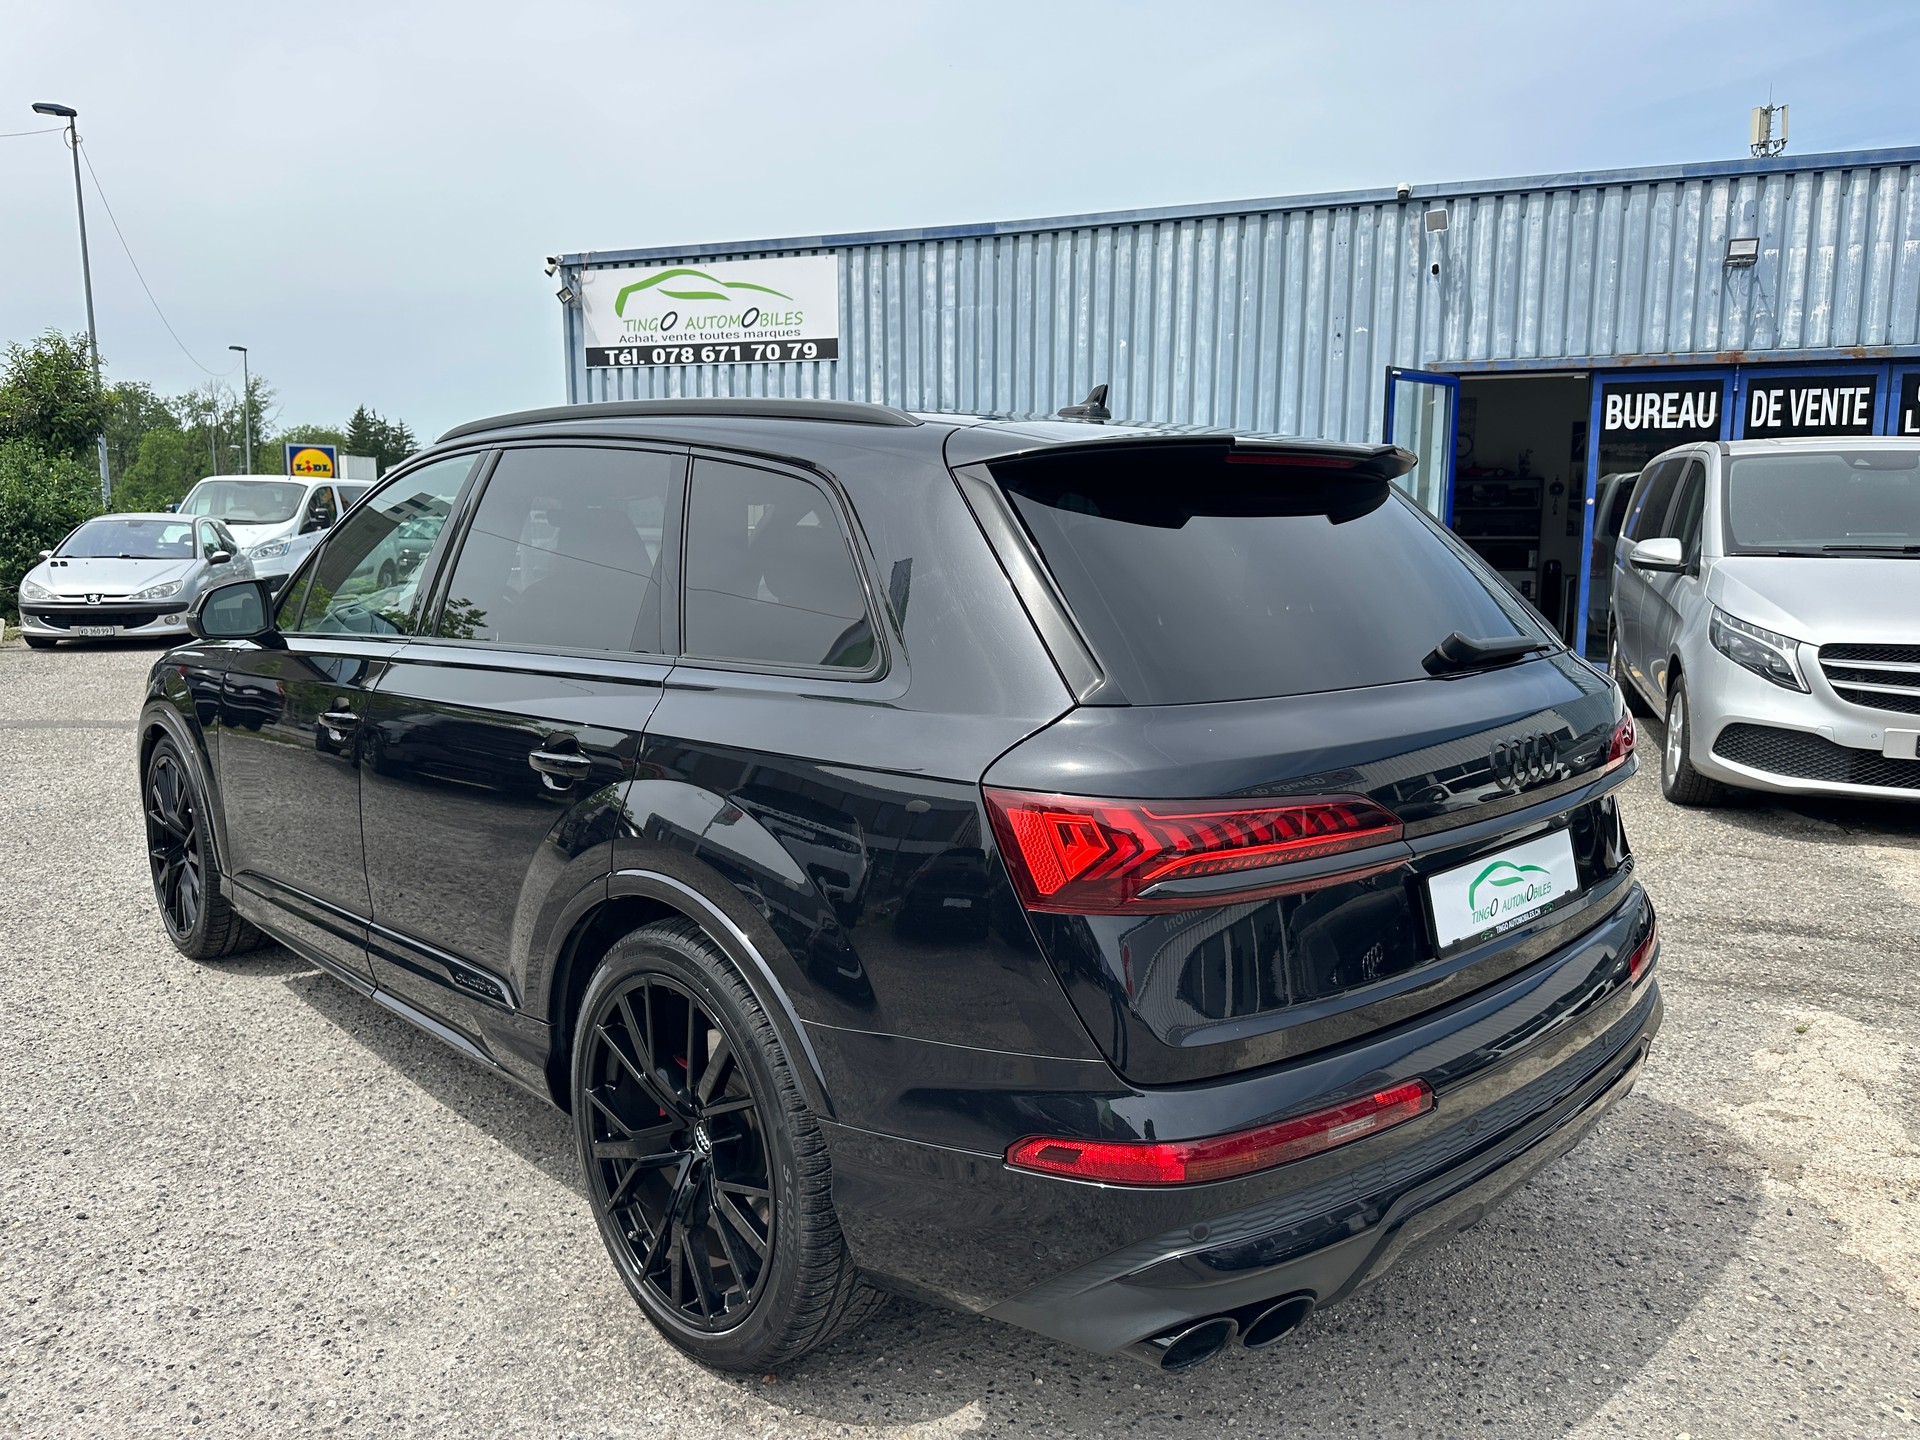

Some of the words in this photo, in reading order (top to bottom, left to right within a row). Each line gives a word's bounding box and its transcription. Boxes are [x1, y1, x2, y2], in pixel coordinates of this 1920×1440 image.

[623, 311, 678, 332] TINGO
[685, 307, 803, 330] AUTOMOBILES
[619, 334, 658, 343] Achat,
[661, 333, 696, 341] vente
[700, 331, 740, 340] toutes
[744, 329, 801, 339] marques
[605, 348, 645, 365] Tél.
[652, 347, 694, 364] 078
[701, 345, 740, 362] 671
[750, 344, 781, 361] 70
[787, 342, 818, 359] 79
[1604, 391, 1717, 431] BUREAU
[1750, 389, 1784, 427] DE
[1790, 387, 1871, 426] VENTE
[1472, 898, 1498, 924] TINGO
[1502, 882, 1551, 912] AUTOMOBILES
